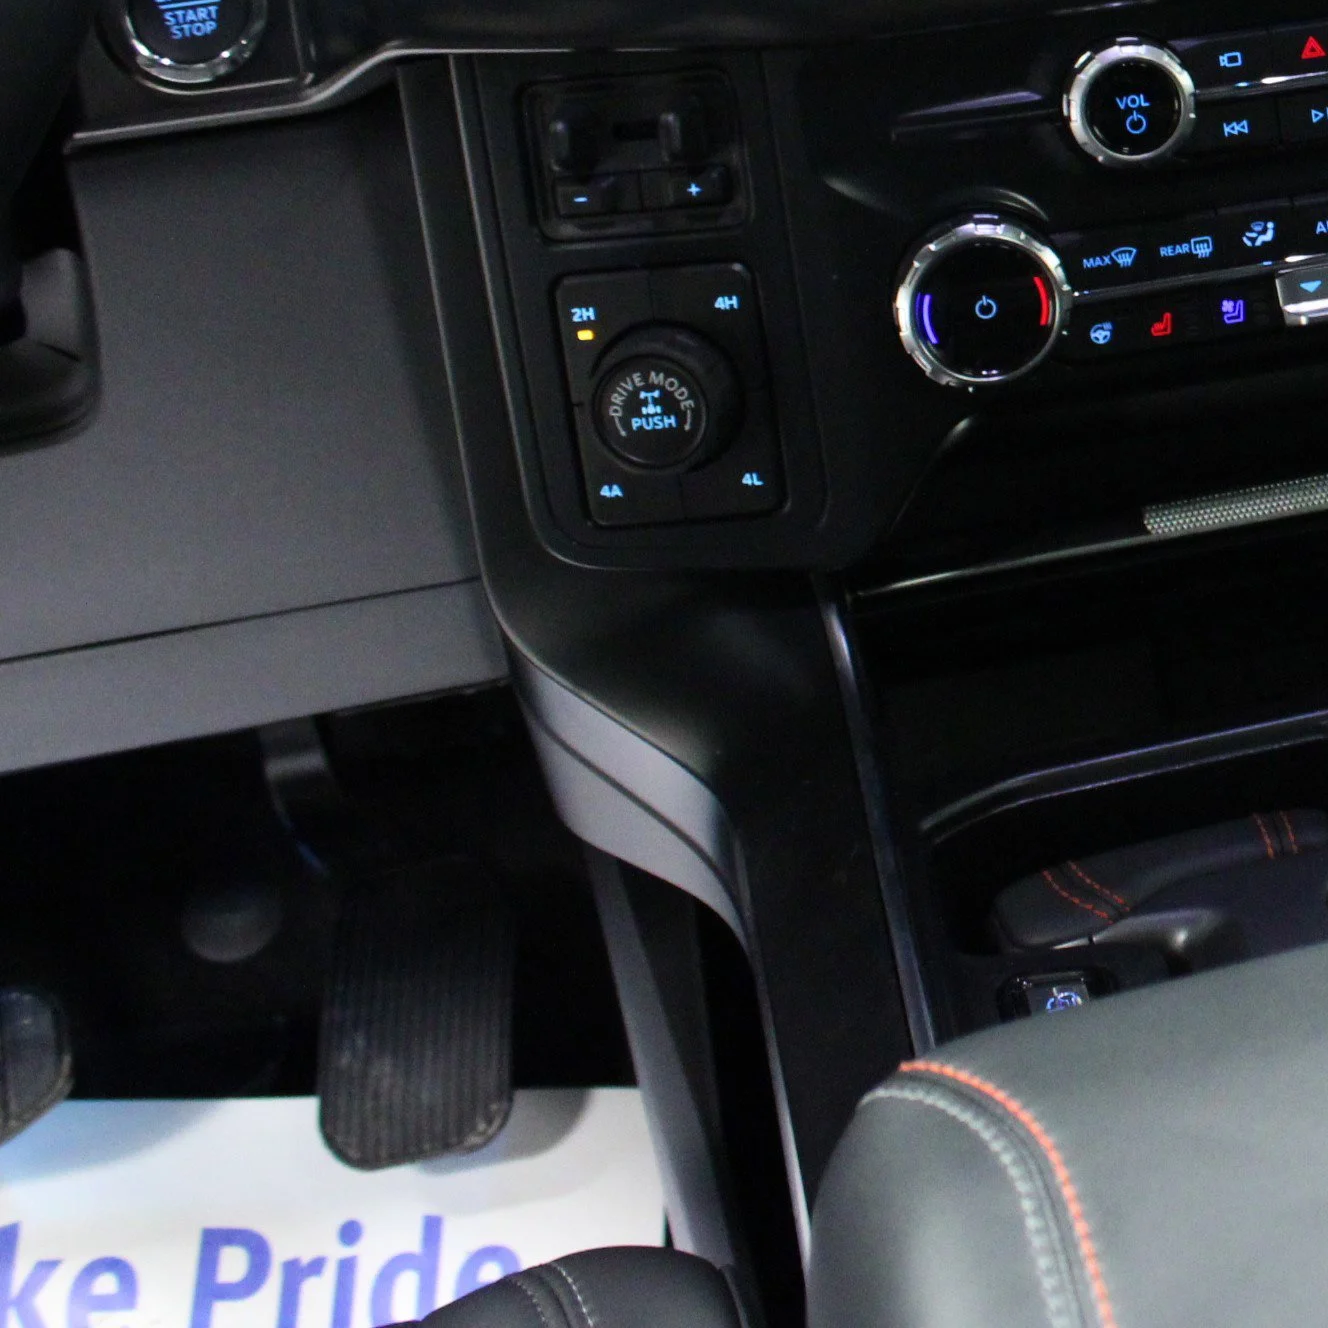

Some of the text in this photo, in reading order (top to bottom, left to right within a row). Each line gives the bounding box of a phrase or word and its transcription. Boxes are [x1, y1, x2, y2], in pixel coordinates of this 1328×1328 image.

[163, 5, 218, 26] START
[170, 21, 218, 40] STOP
[1115, 94, 1150, 110] VOL
[1159, 244, 1190, 258] REAR
[1083, 255, 1112, 269] MAX
[714, 295, 739, 311] 4H
[570, 306, 596, 323] 2H
[609, 370, 695, 417] DRIVE MODE
[631, 414, 677, 431] PUSH
[741, 473, 764, 487] 4L
[600, 484, 624, 498] 4A
